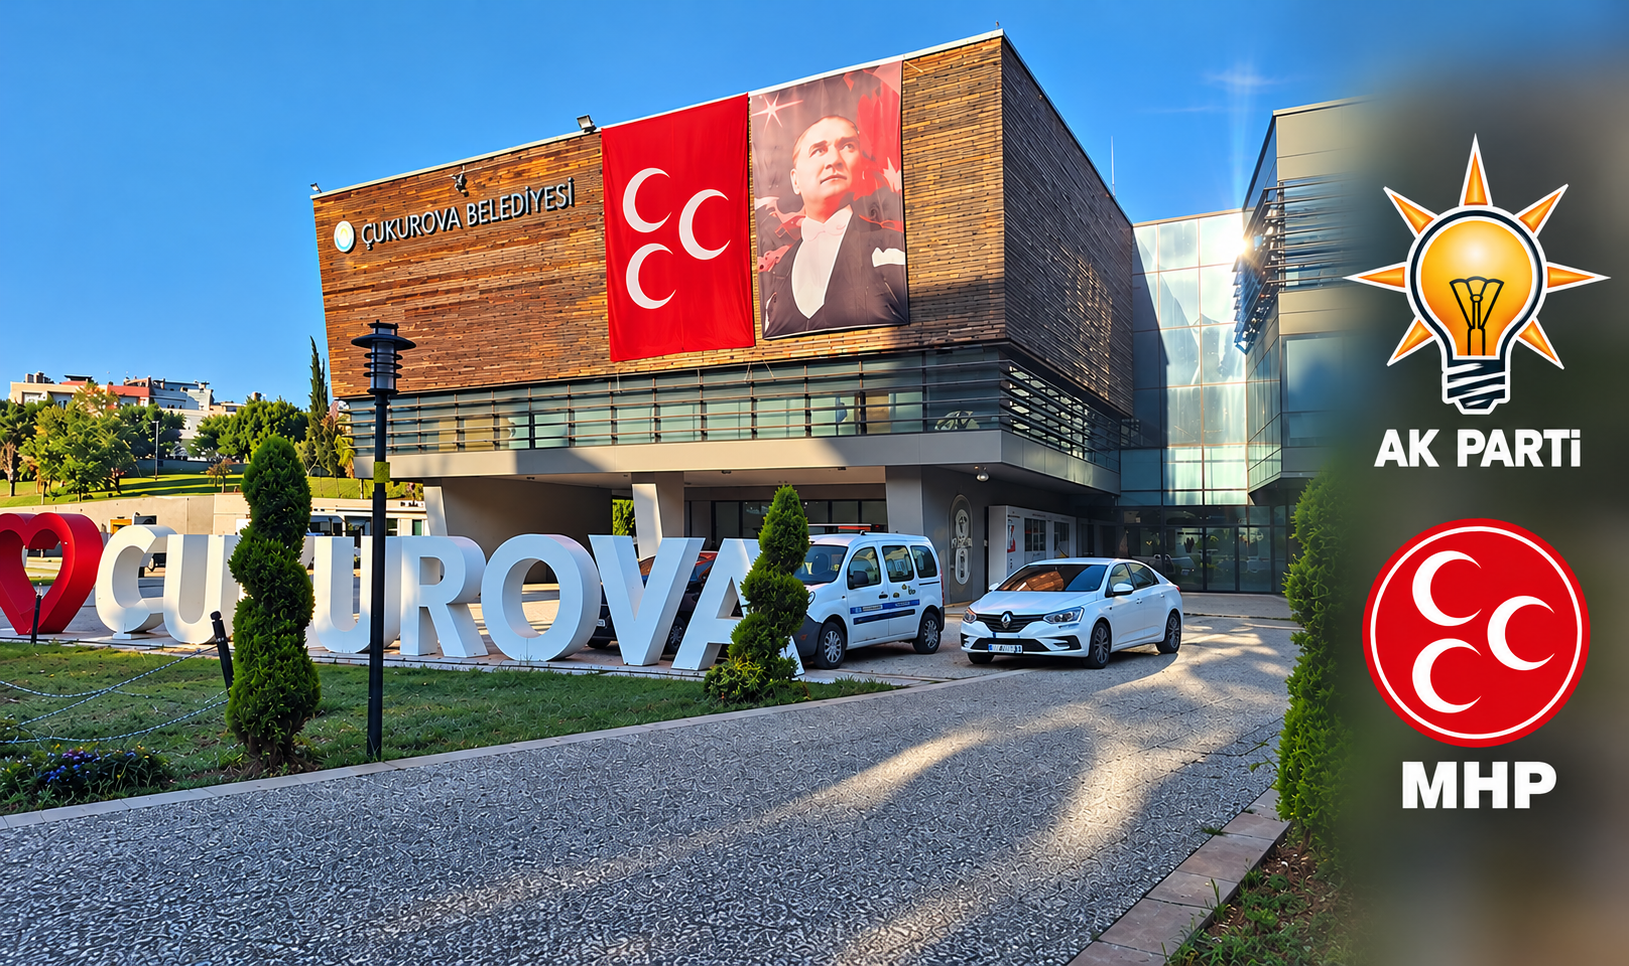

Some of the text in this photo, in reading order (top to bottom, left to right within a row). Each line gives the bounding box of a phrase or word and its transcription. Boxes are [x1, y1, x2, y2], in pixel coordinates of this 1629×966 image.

[361, 177, 574, 249] ÇUKUROVA BELEDİYESİ
[95, 525, 805, 676] ÇUUROVA
